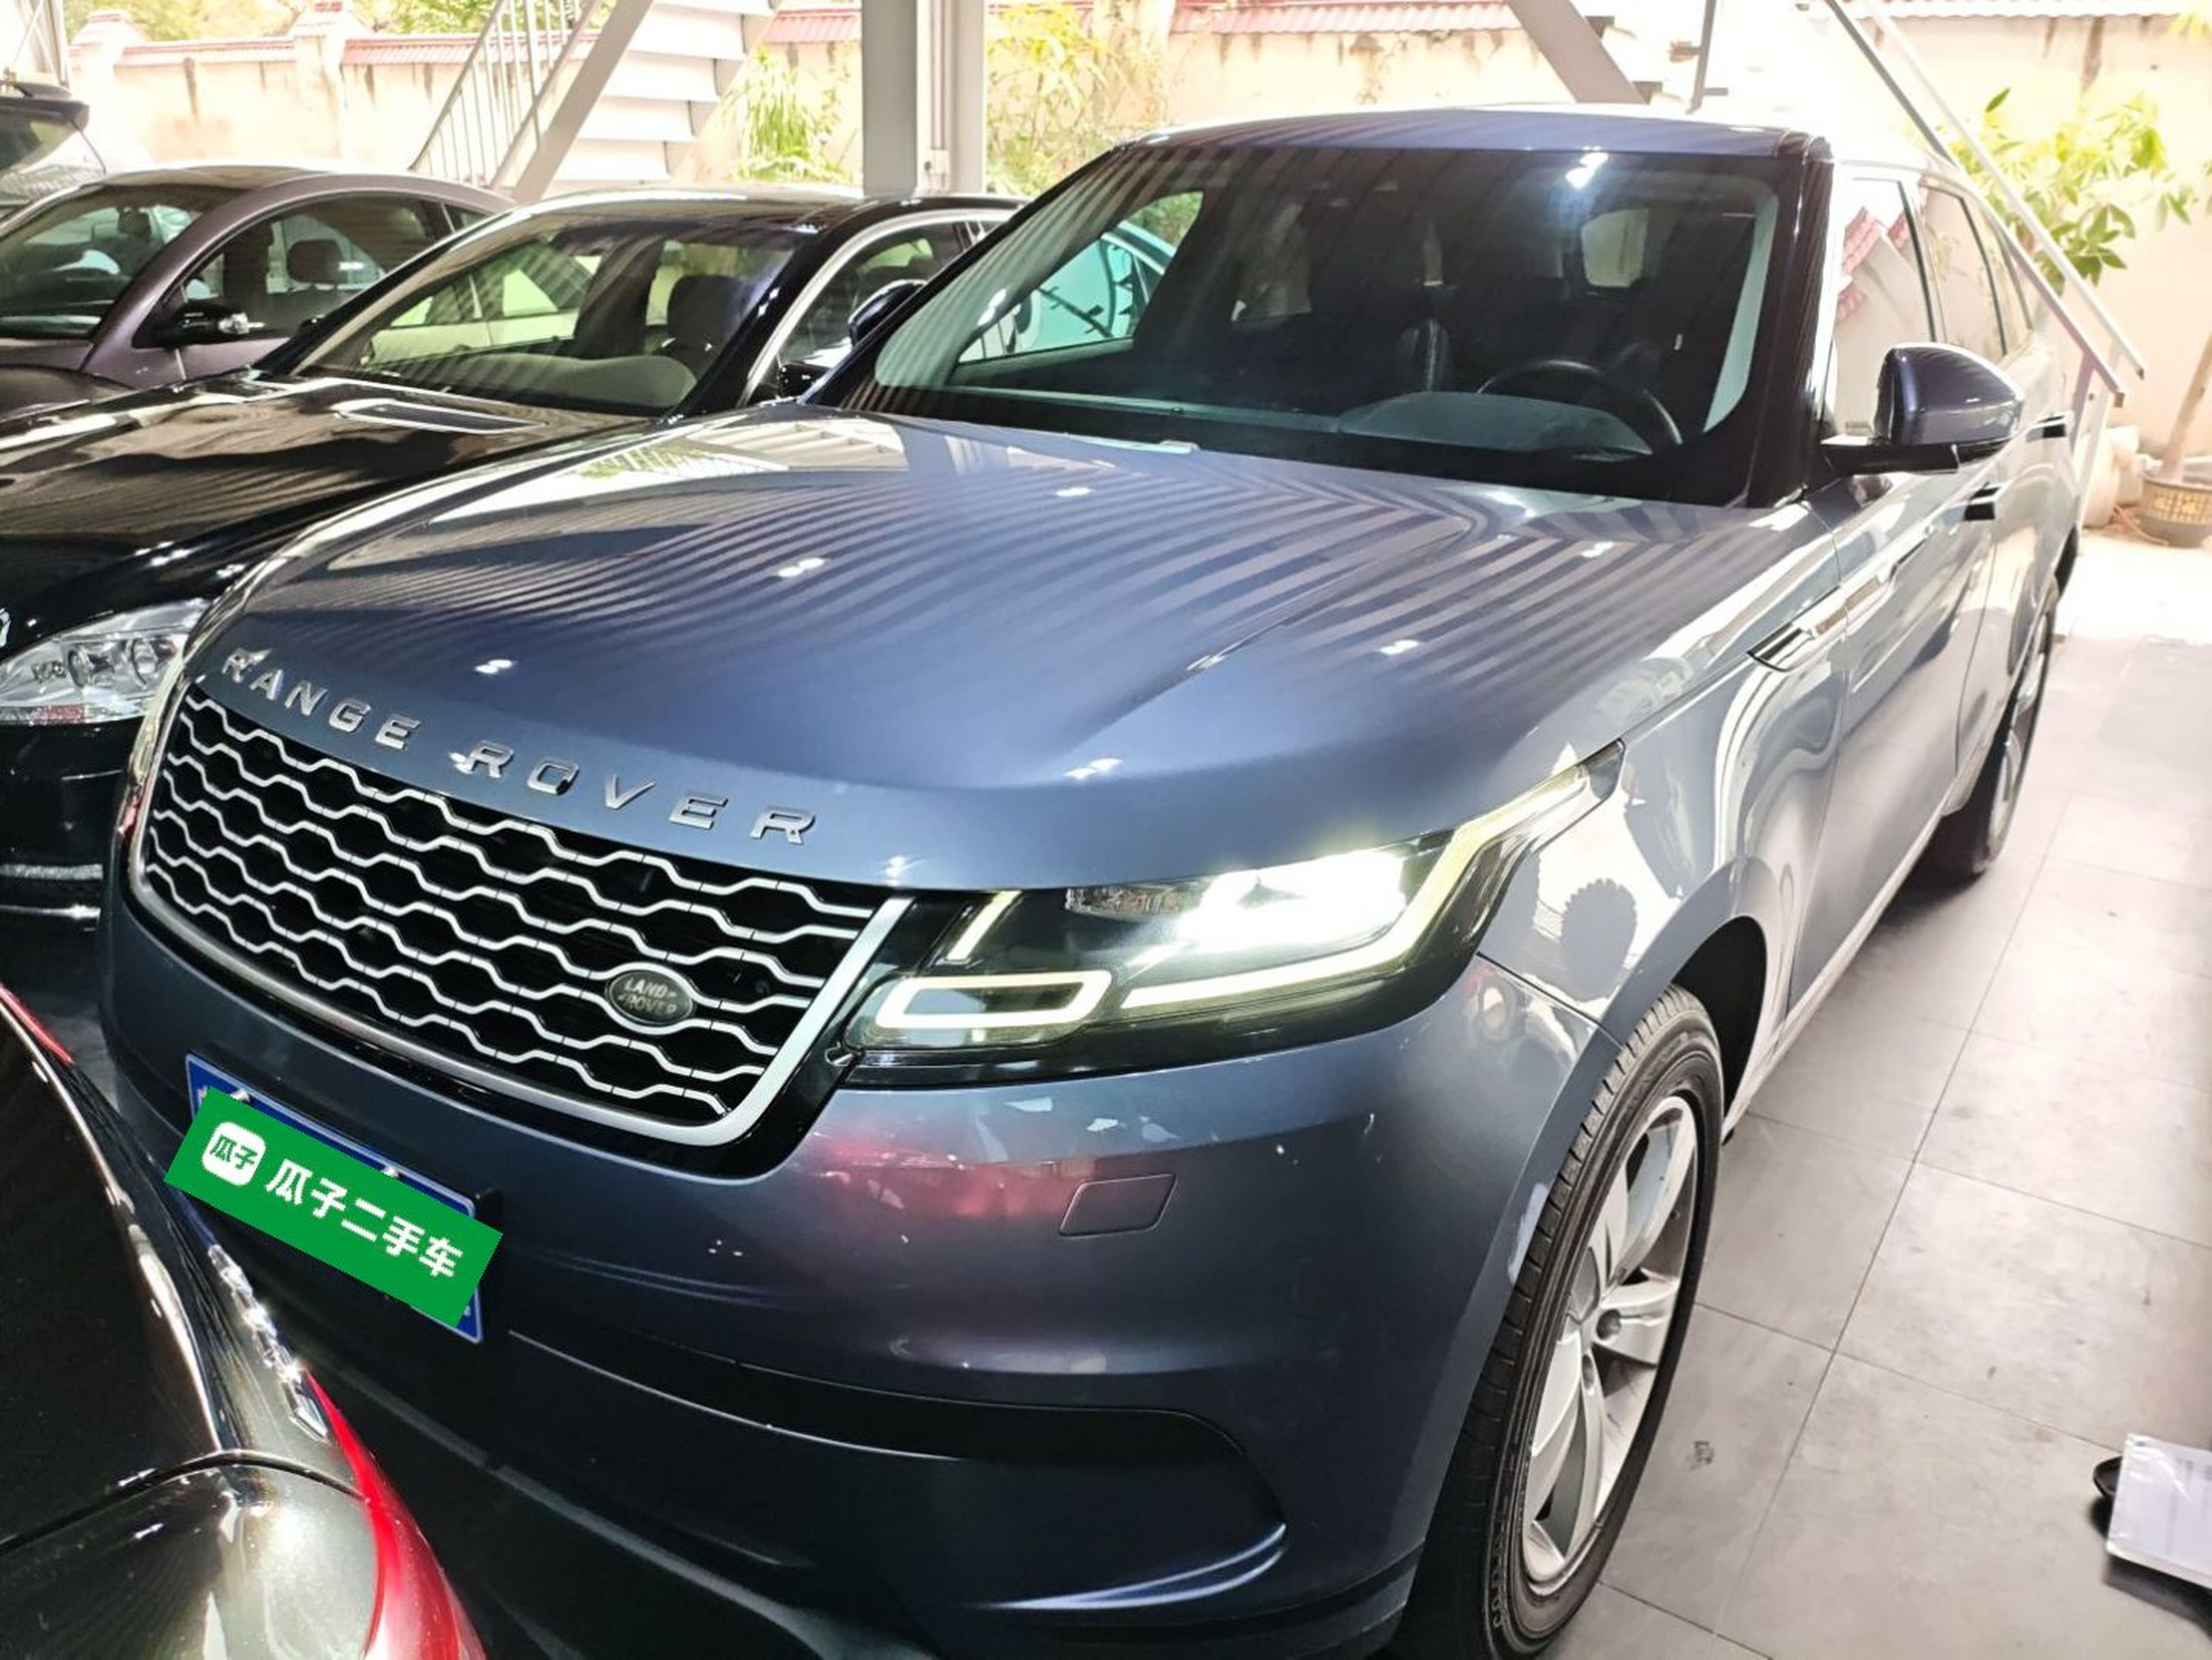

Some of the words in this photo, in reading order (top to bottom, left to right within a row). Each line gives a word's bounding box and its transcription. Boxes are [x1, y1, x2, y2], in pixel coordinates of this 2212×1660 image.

[221, 647, 422, 750] RANGE
[460, 740, 816, 844] ROVER
[624, 977, 669, 999] LAND
[622, 993, 677, 1015] ROVER
